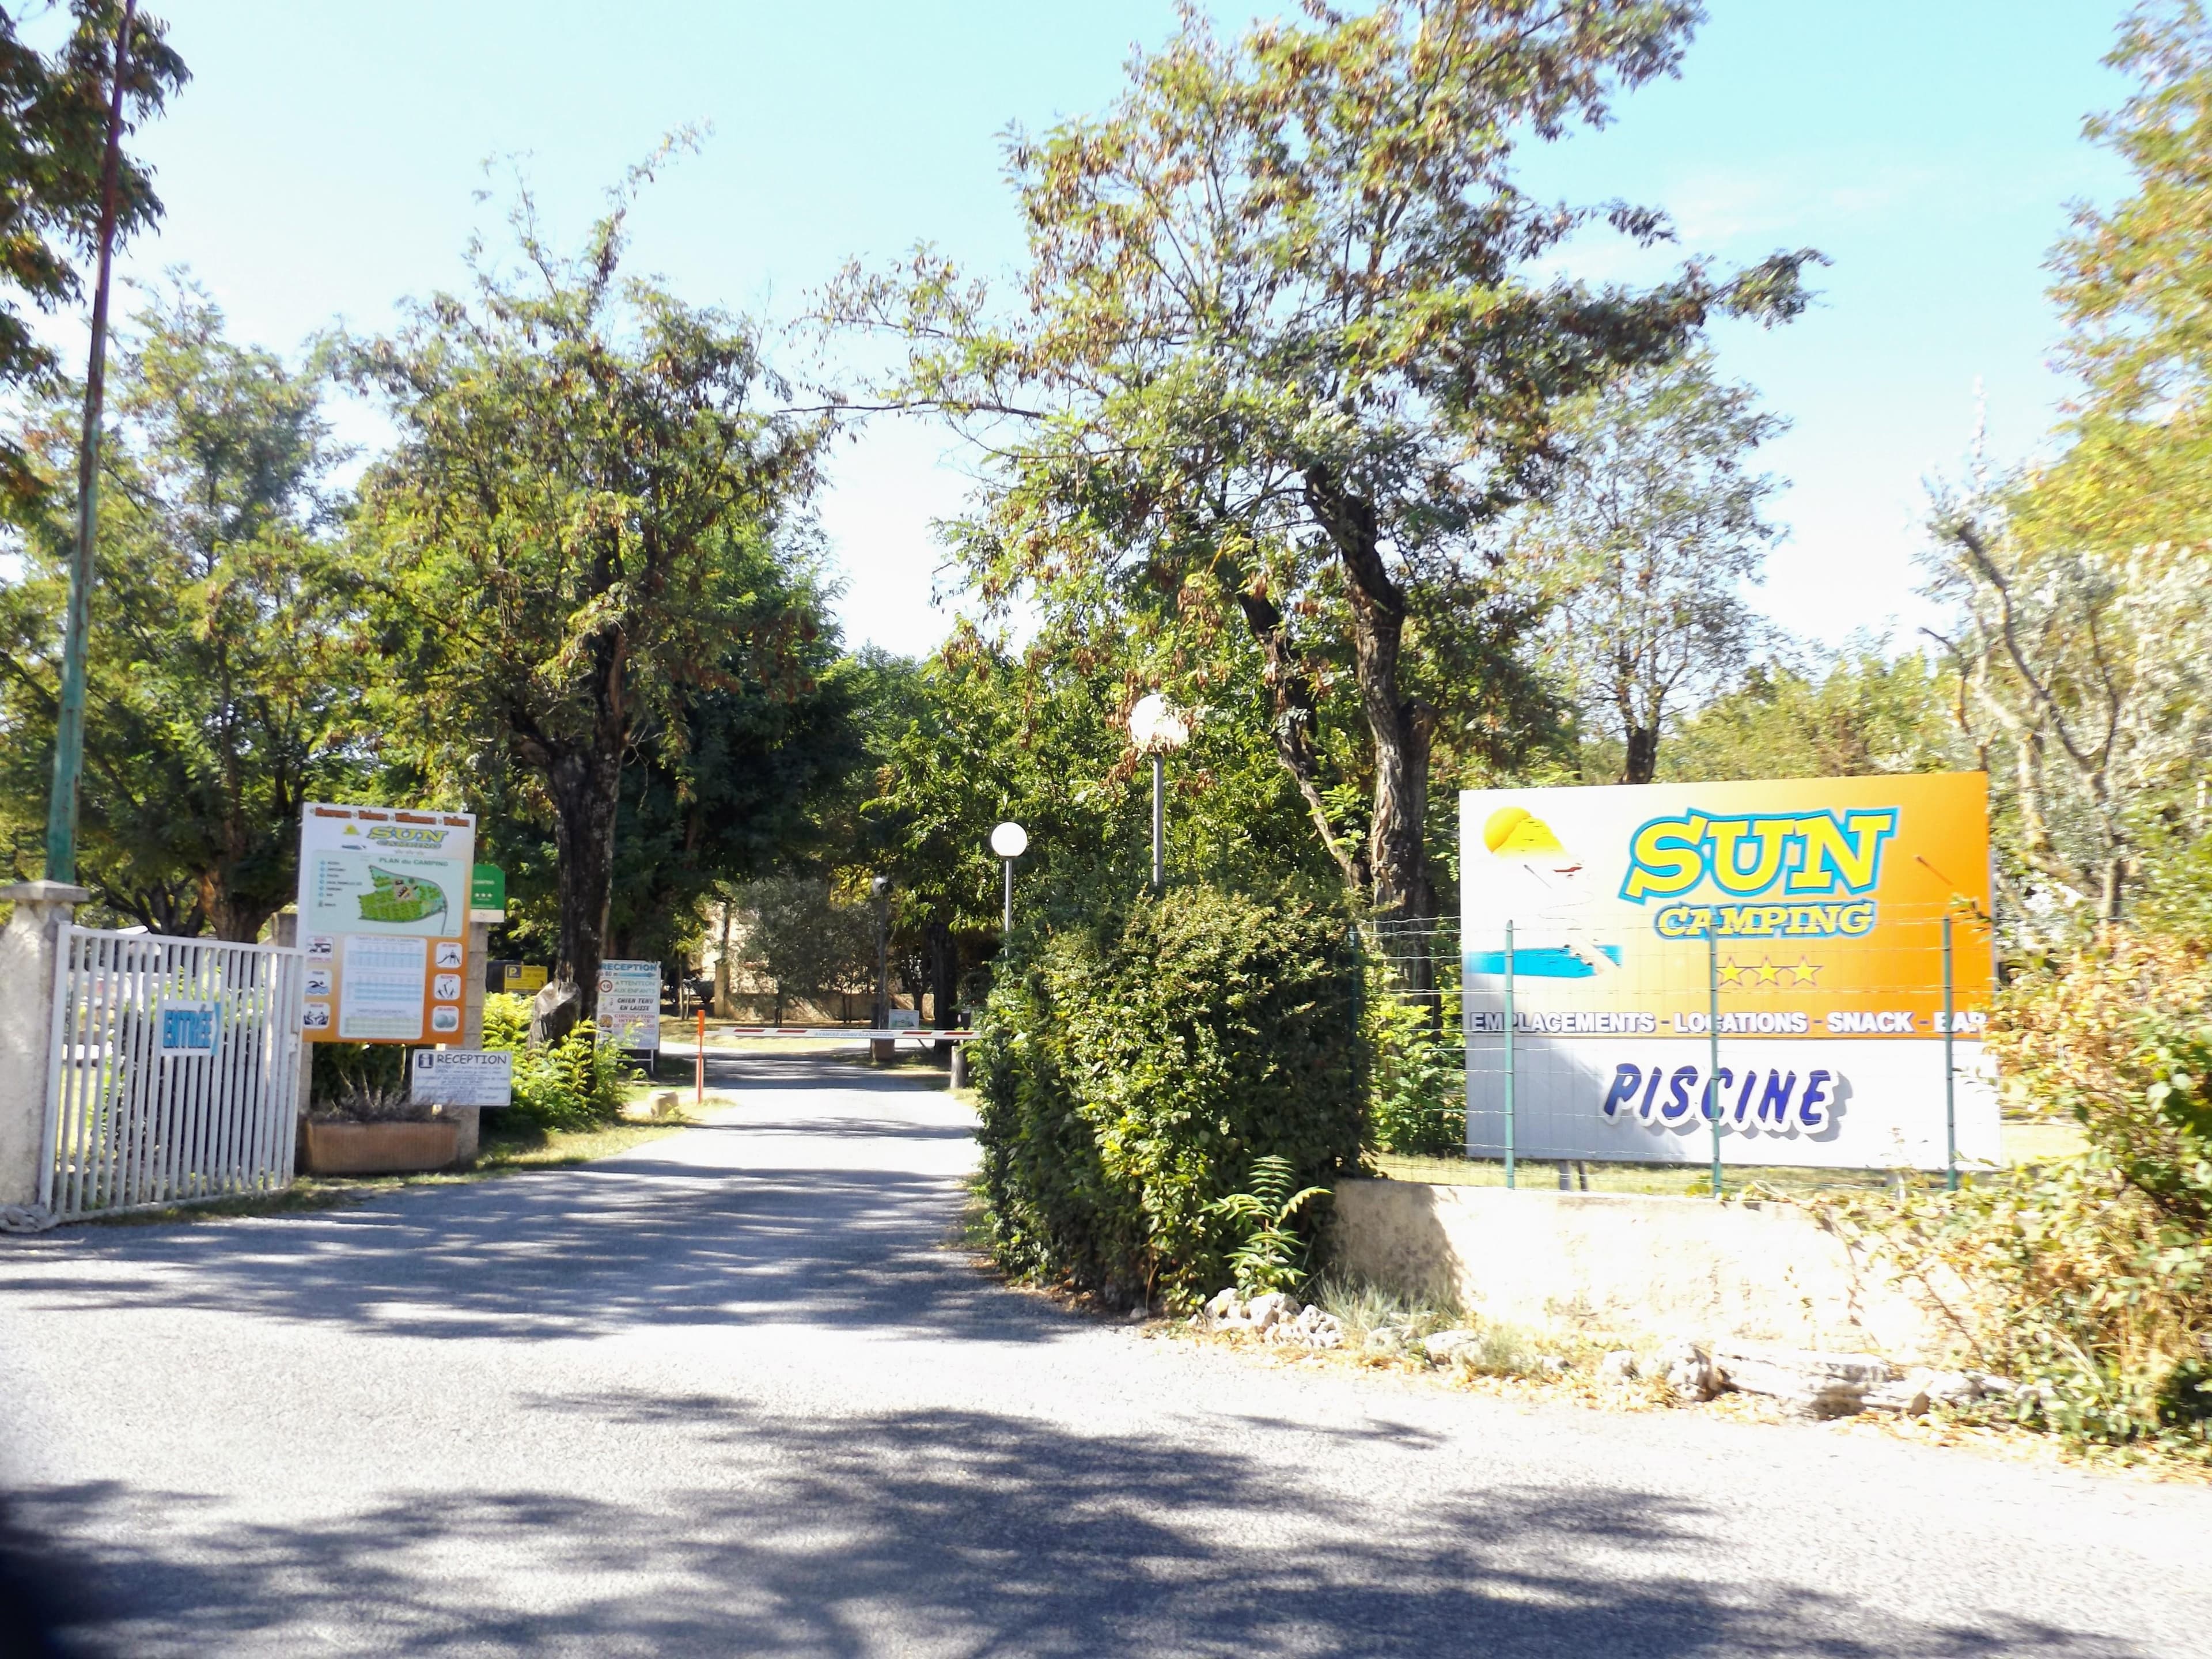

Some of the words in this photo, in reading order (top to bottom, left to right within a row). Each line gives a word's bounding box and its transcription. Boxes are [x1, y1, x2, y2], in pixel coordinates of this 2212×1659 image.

[366, 826, 449, 843] SUN
[414, 859, 449, 867] CAMPING
[1618, 807, 1899, 905] SUN
[1655, 900, 1876, 940] CAMPING
[1672, 1011, 1808, 1033] LOCATIONS
[1827, 1010, 1914, 1033] SNACK
[437, 1054, 507, 1065] RECEPTION
[1604, 1063, 1831, 1126] PISCINE
